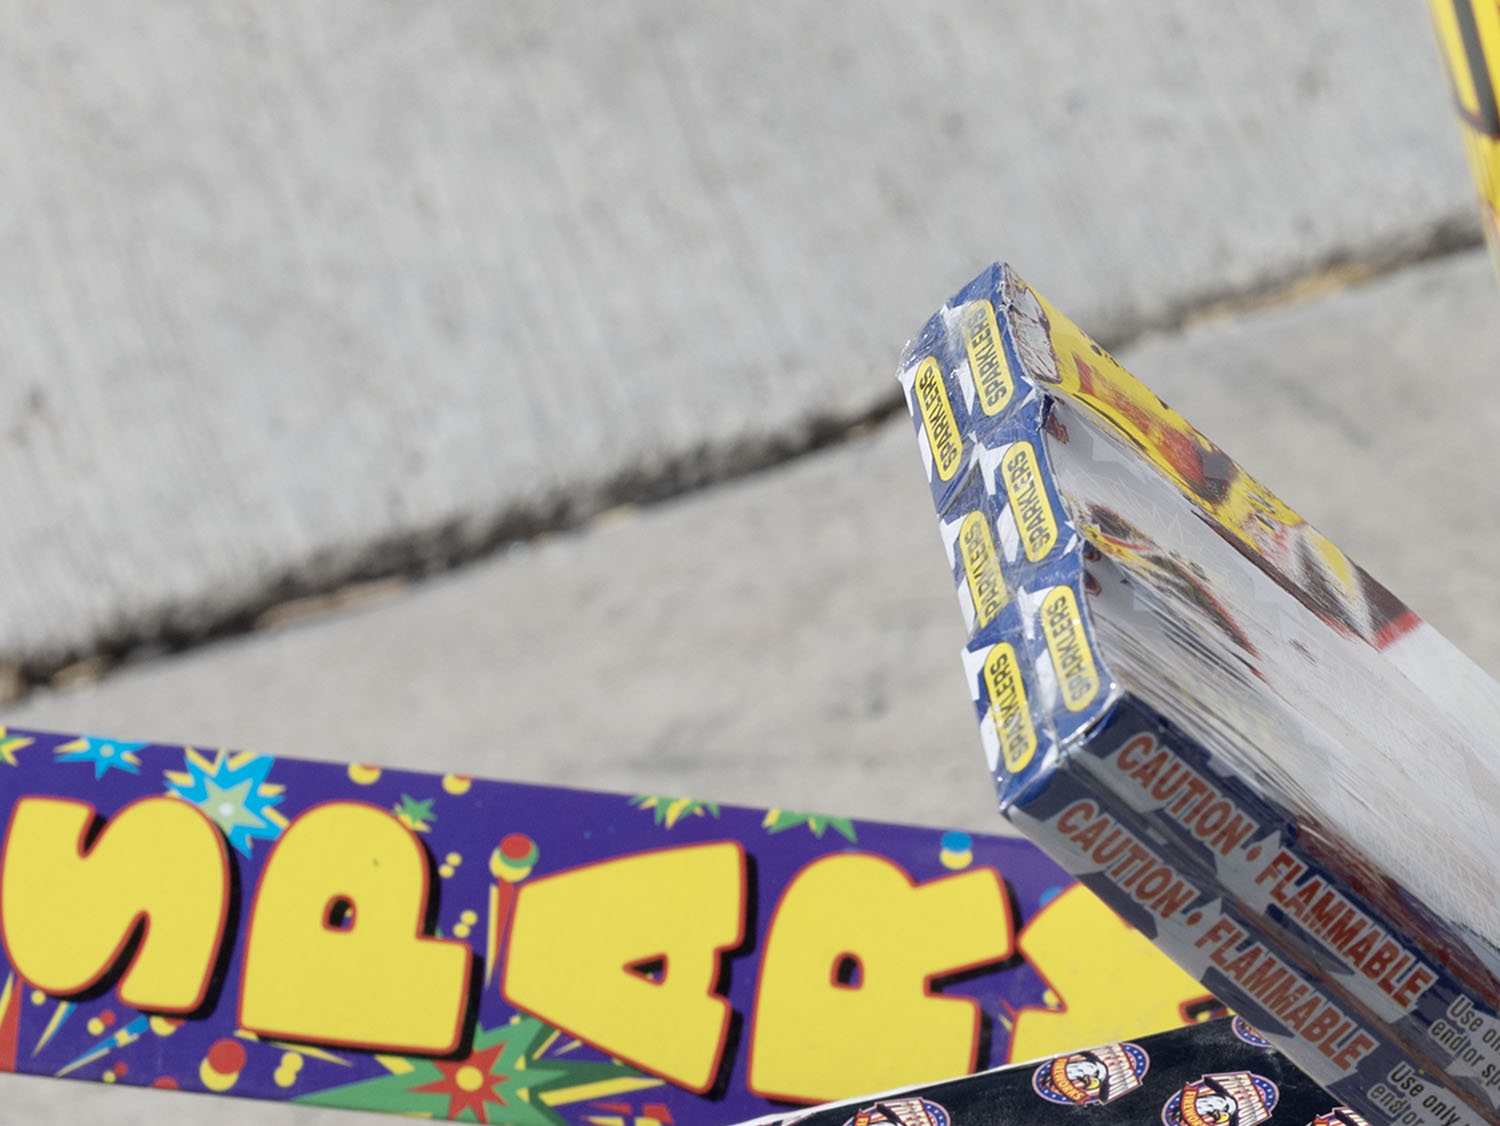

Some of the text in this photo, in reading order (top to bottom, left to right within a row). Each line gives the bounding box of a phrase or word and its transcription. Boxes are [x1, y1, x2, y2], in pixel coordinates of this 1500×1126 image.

[965, 306, 1006, 409] SPARKLERS
[916, 363, 957, 473] SPARKLERS
[1007, 452, 1050, 554] SPARKLERS
[961, 520, 1000, 619] PARKLERS
[1045, 595, 1090, 704] SPARKLERS
[987, 649, 1029, 766] SPARKLERS
[1106, 732, 1440, 1008] CAUTION FLAMMABLE
[1050, 797, 1200, 919] CAUTION
[1189, 917, 1380, 1072] FLAMMABLE
[1427, 1016, 1468, 1051] end
[1460, 1047, 1485, 1067] or
[1442, 996, 1488, 1034] Use
[1388, 1065, 1429, 1099] Use
